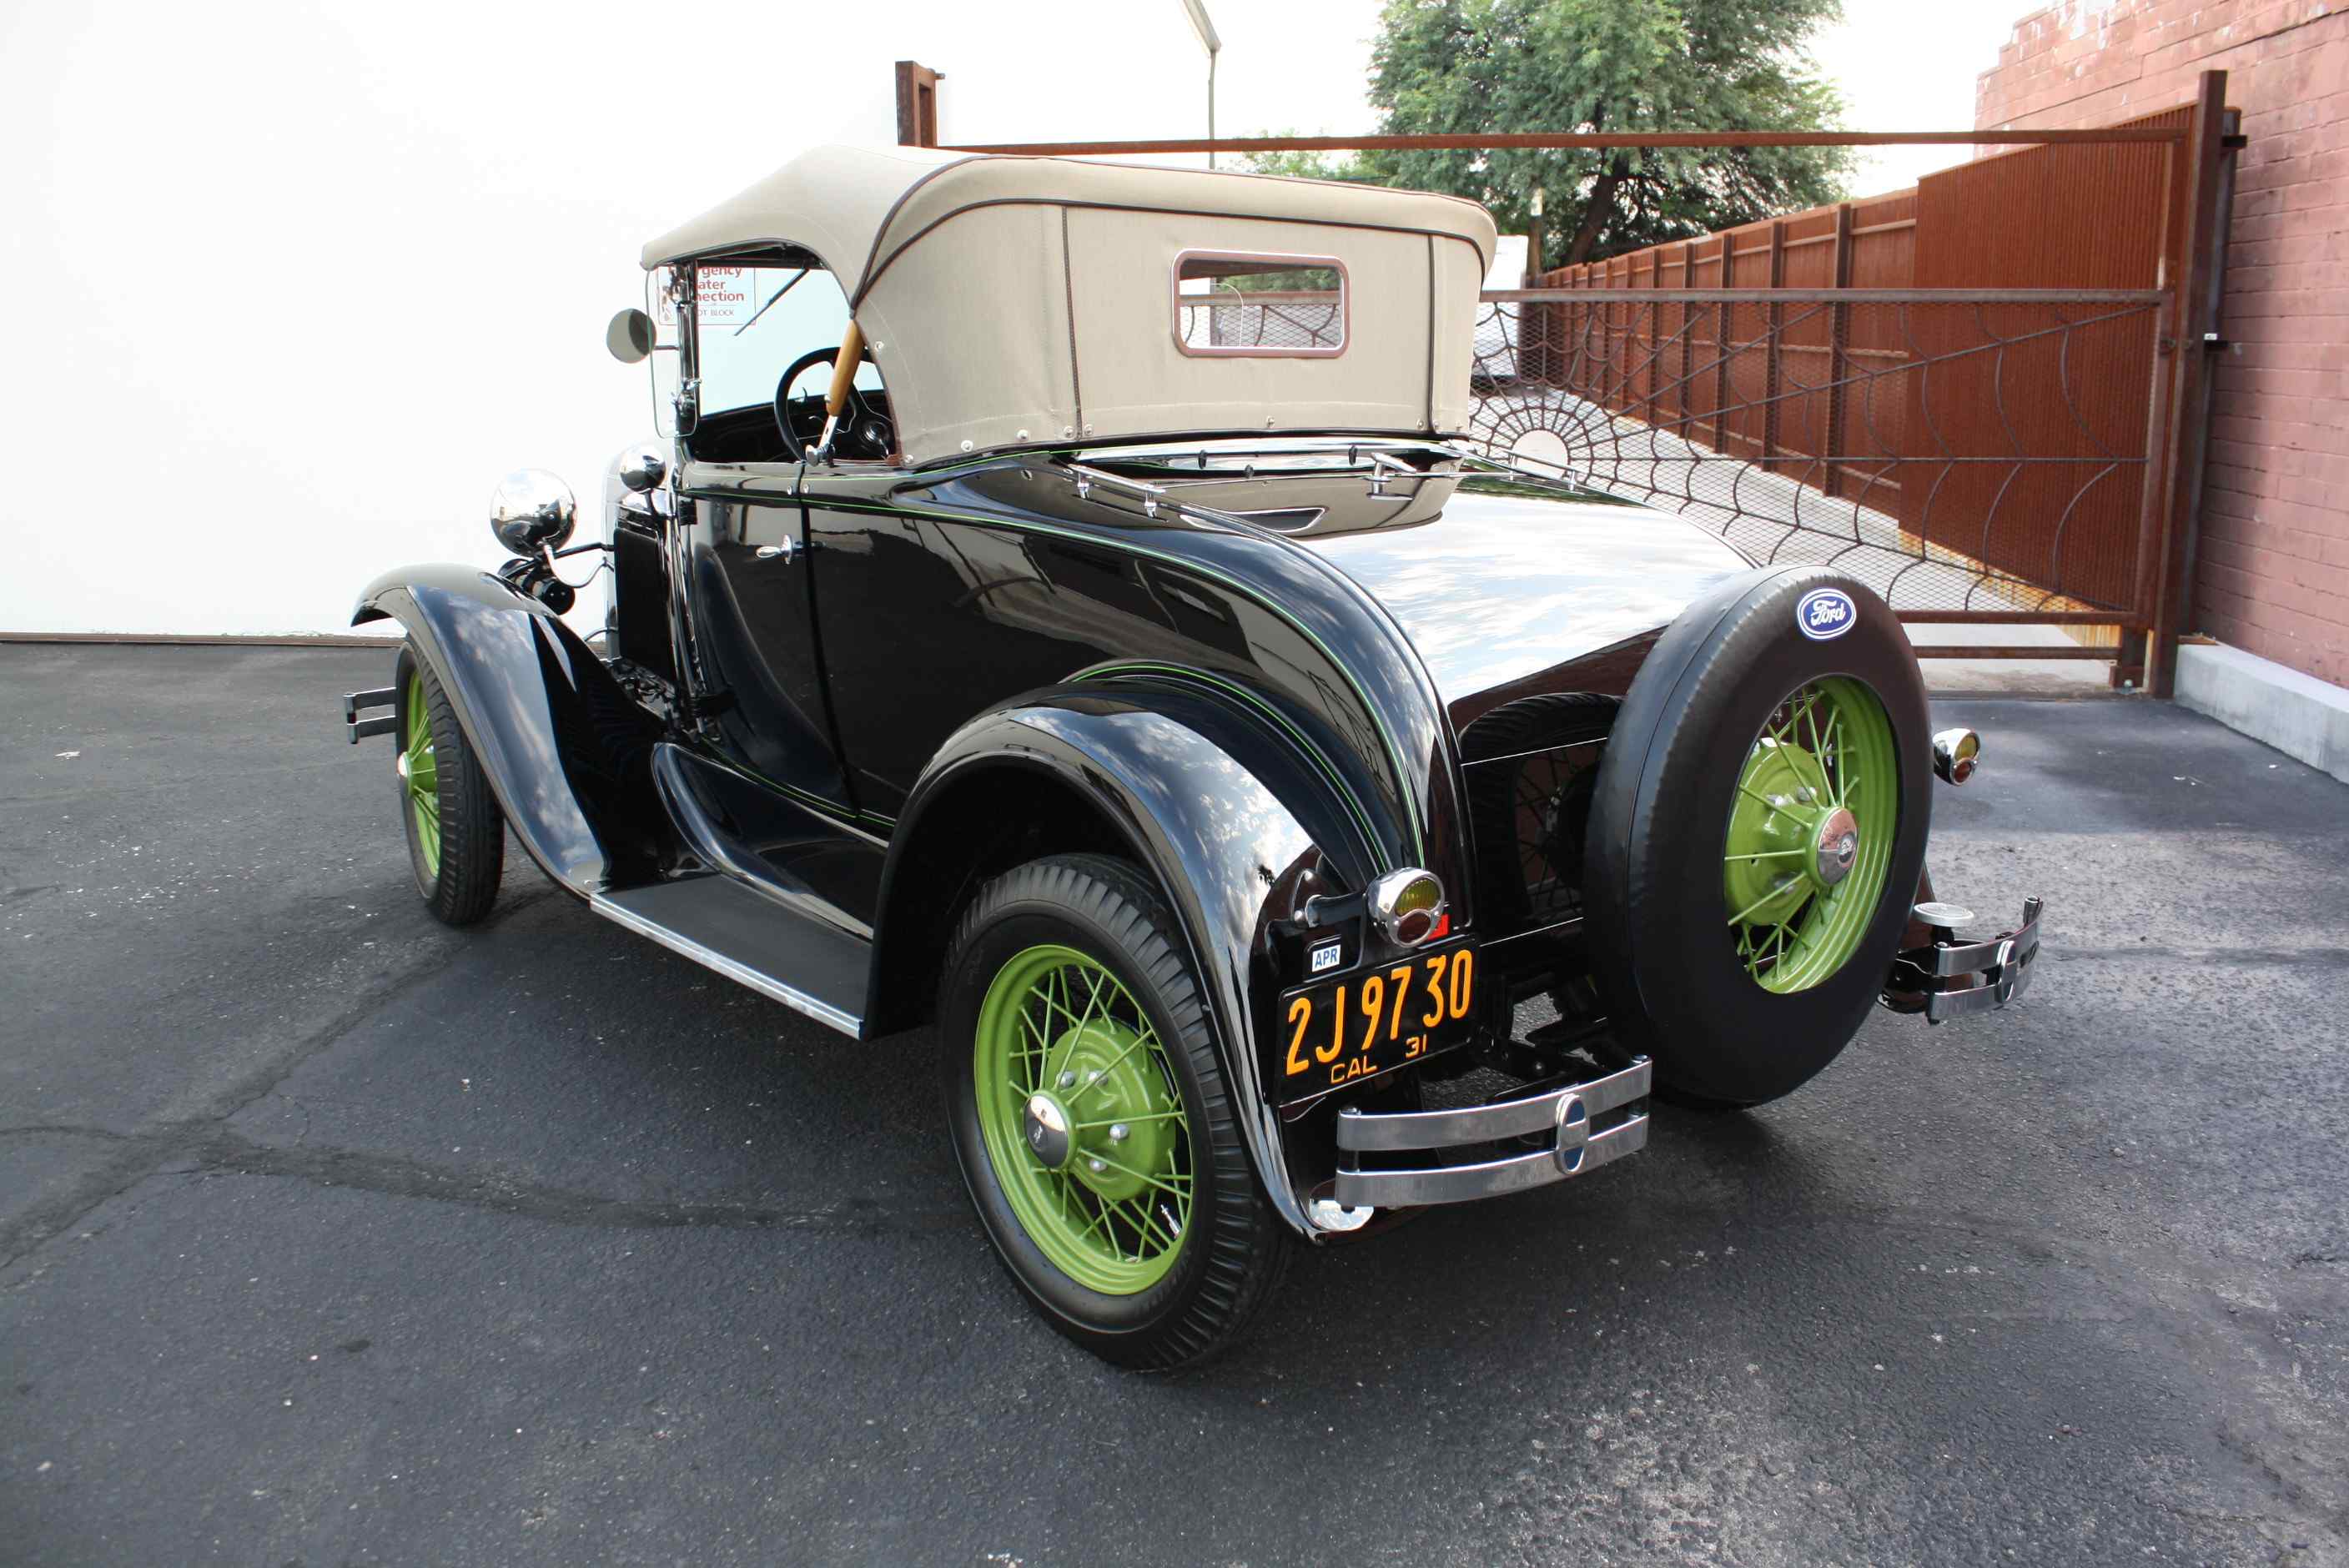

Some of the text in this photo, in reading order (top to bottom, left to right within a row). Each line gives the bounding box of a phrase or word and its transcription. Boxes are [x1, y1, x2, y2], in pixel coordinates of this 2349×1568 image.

[698, 279, 726, 290] ater
[696, 289, 744, 301] nection
[711, 309, 735, 317] BLOCK
[1810, 600, 1846, 626] Ford
[1314, 948, 1339, 968] APR
[1330, 1034, 1427, 1084] CAL 31
